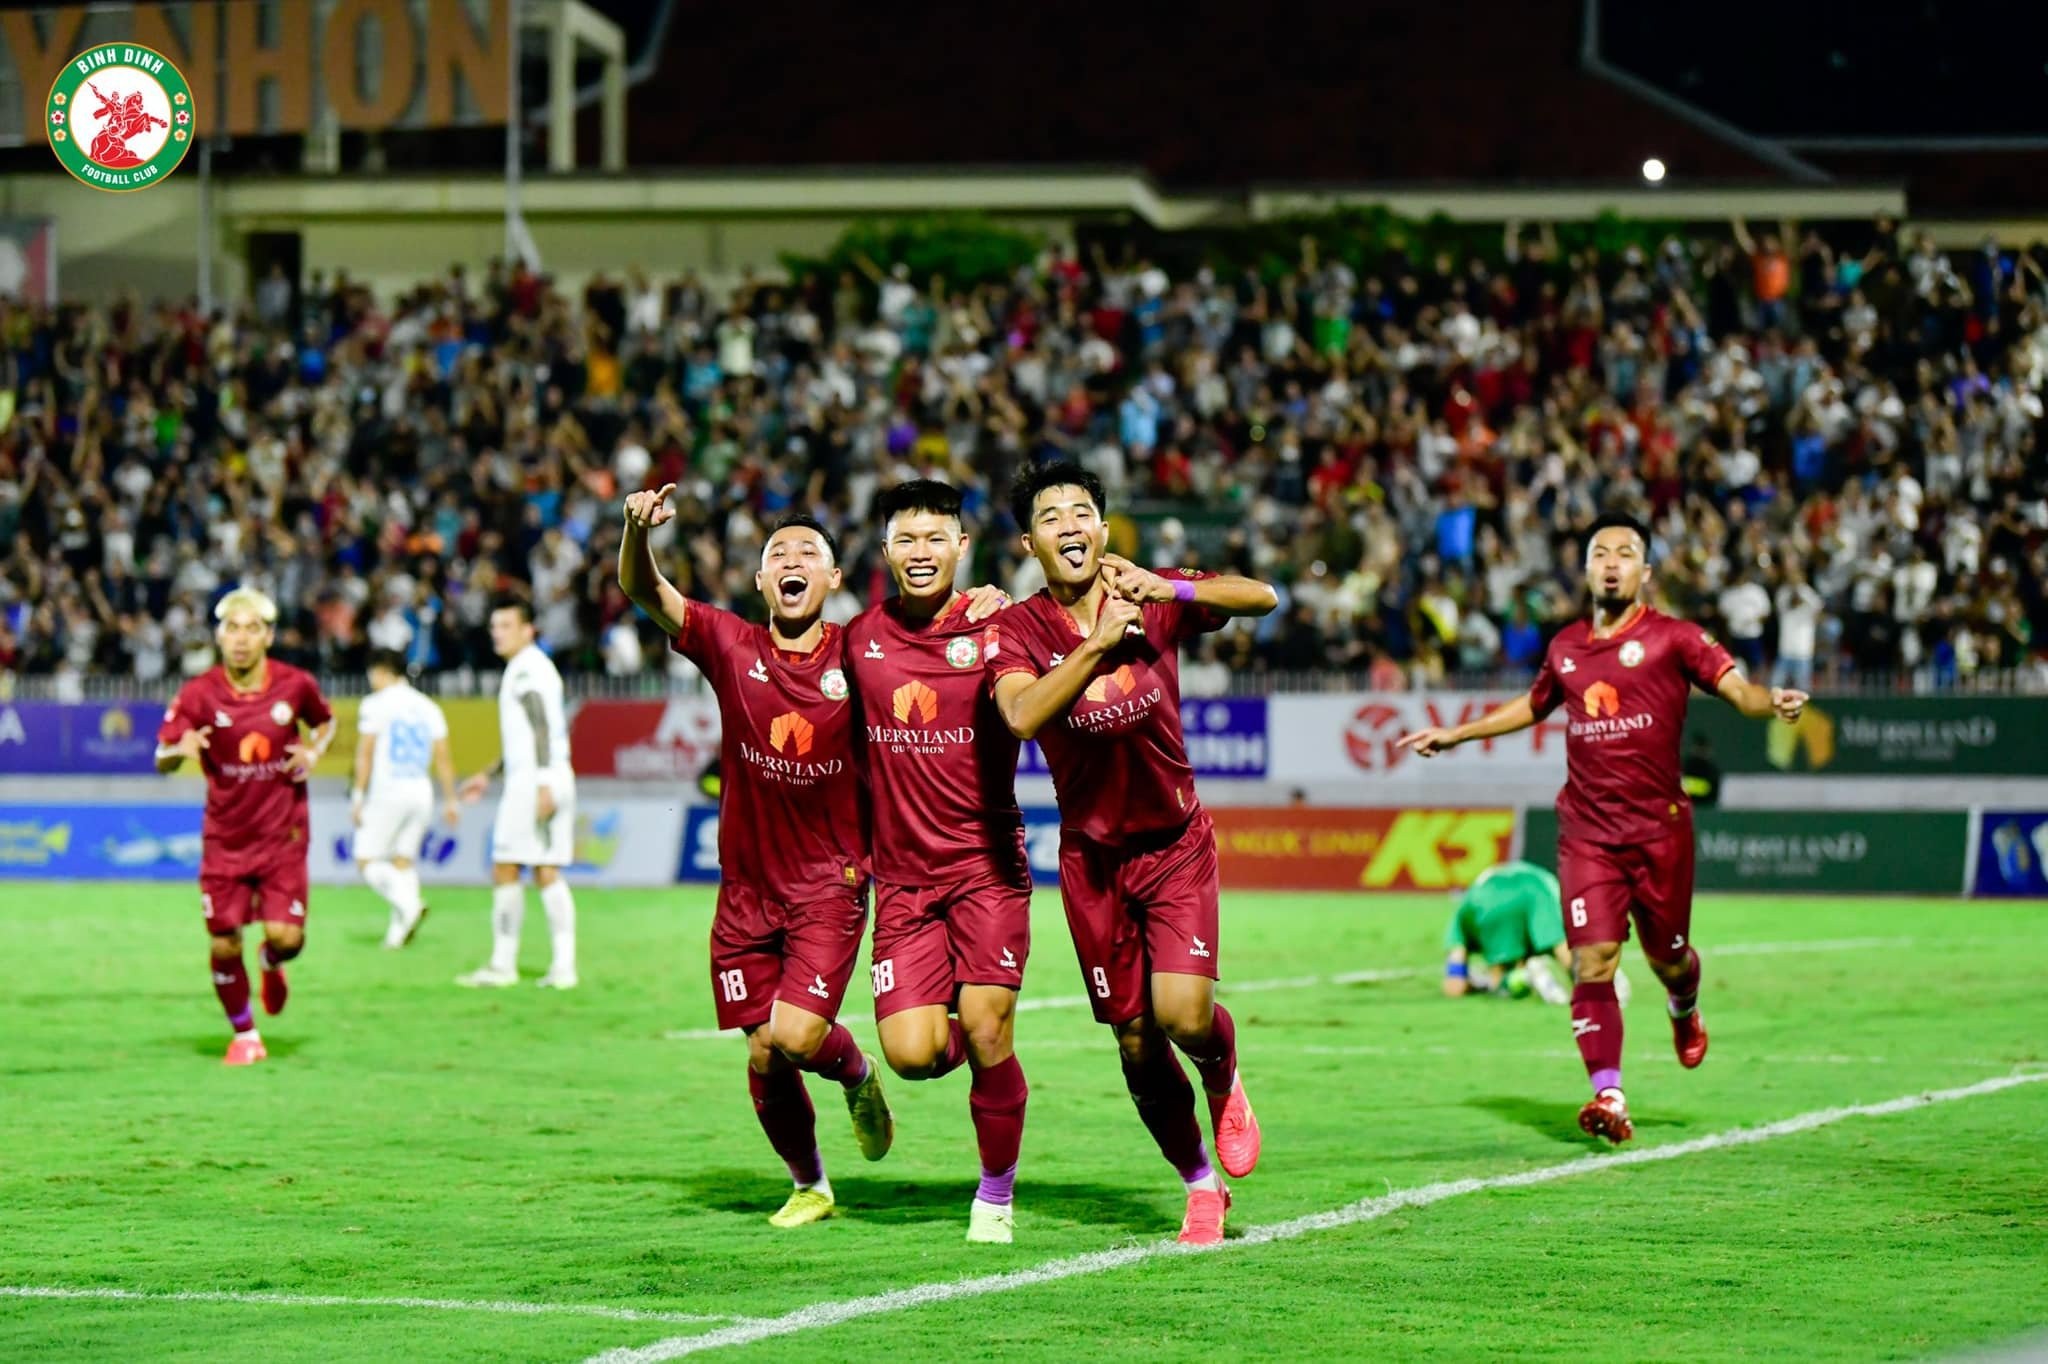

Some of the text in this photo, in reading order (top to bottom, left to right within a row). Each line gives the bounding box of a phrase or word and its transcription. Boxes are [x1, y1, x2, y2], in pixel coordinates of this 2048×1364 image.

[866, 725, 975, 744] MERRYLAND
[741, 742, 842, 777] MERRYLAND
[1571, 897, 1589, 928] 6
[719, 968, 748, 1003] 18
[1093, 966, 1110, 998] 9
